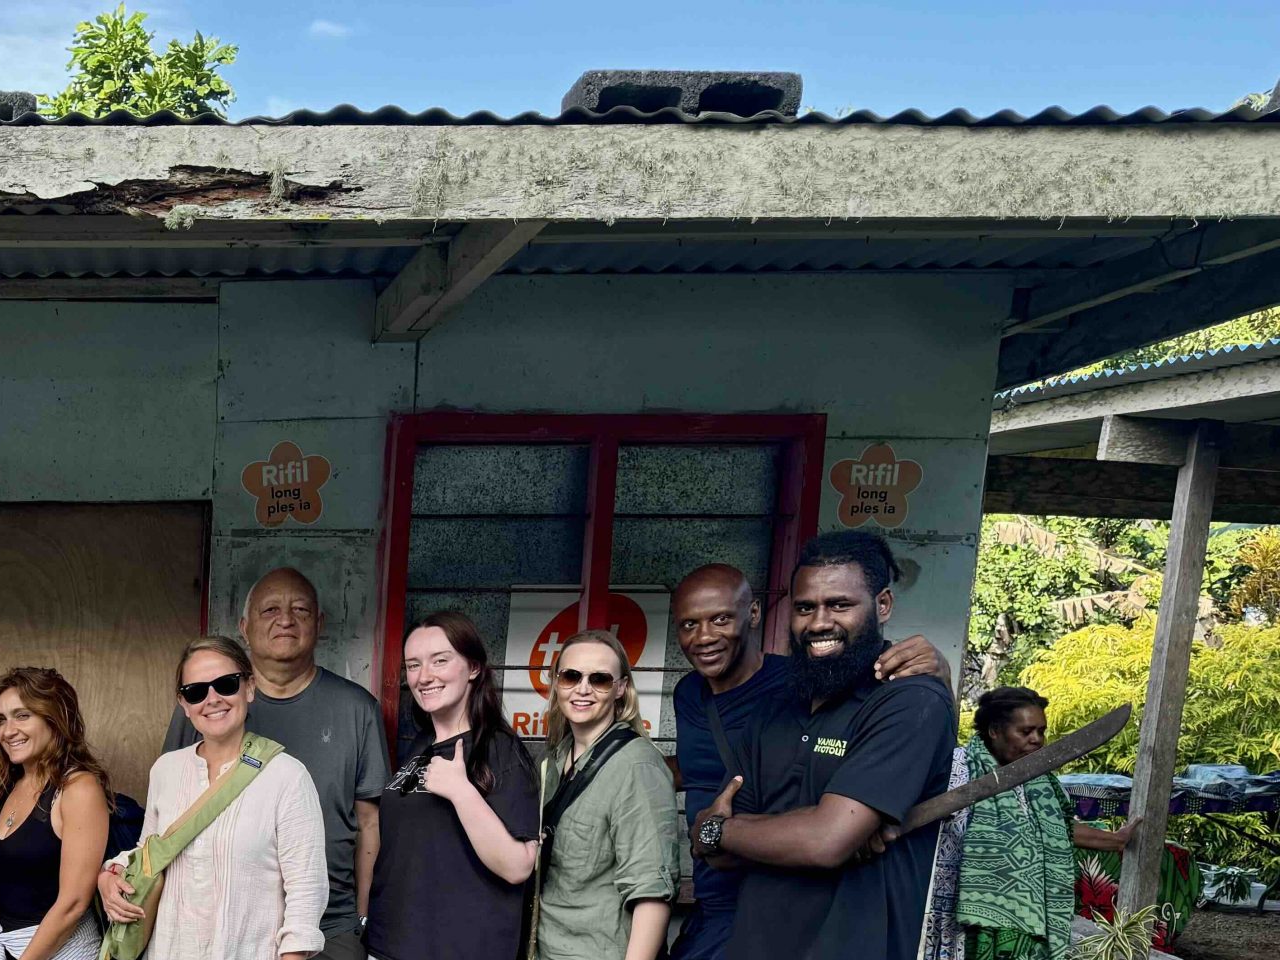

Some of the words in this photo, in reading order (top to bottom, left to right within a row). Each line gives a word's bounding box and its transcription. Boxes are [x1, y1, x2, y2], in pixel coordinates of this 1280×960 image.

[262, 460, 309, 487] Rifil
[850, 463, 900, 486] Rifil
[271, 486, 301, 500] long
[856, 487, 888, 502] long
[267, 502, 295, 517] ples
[299, 499, 311, 511] ia
[850, 502, 879, 517] ples
[883, 502, 896, 515] ia
[512, 712, 549, 736] Rif
